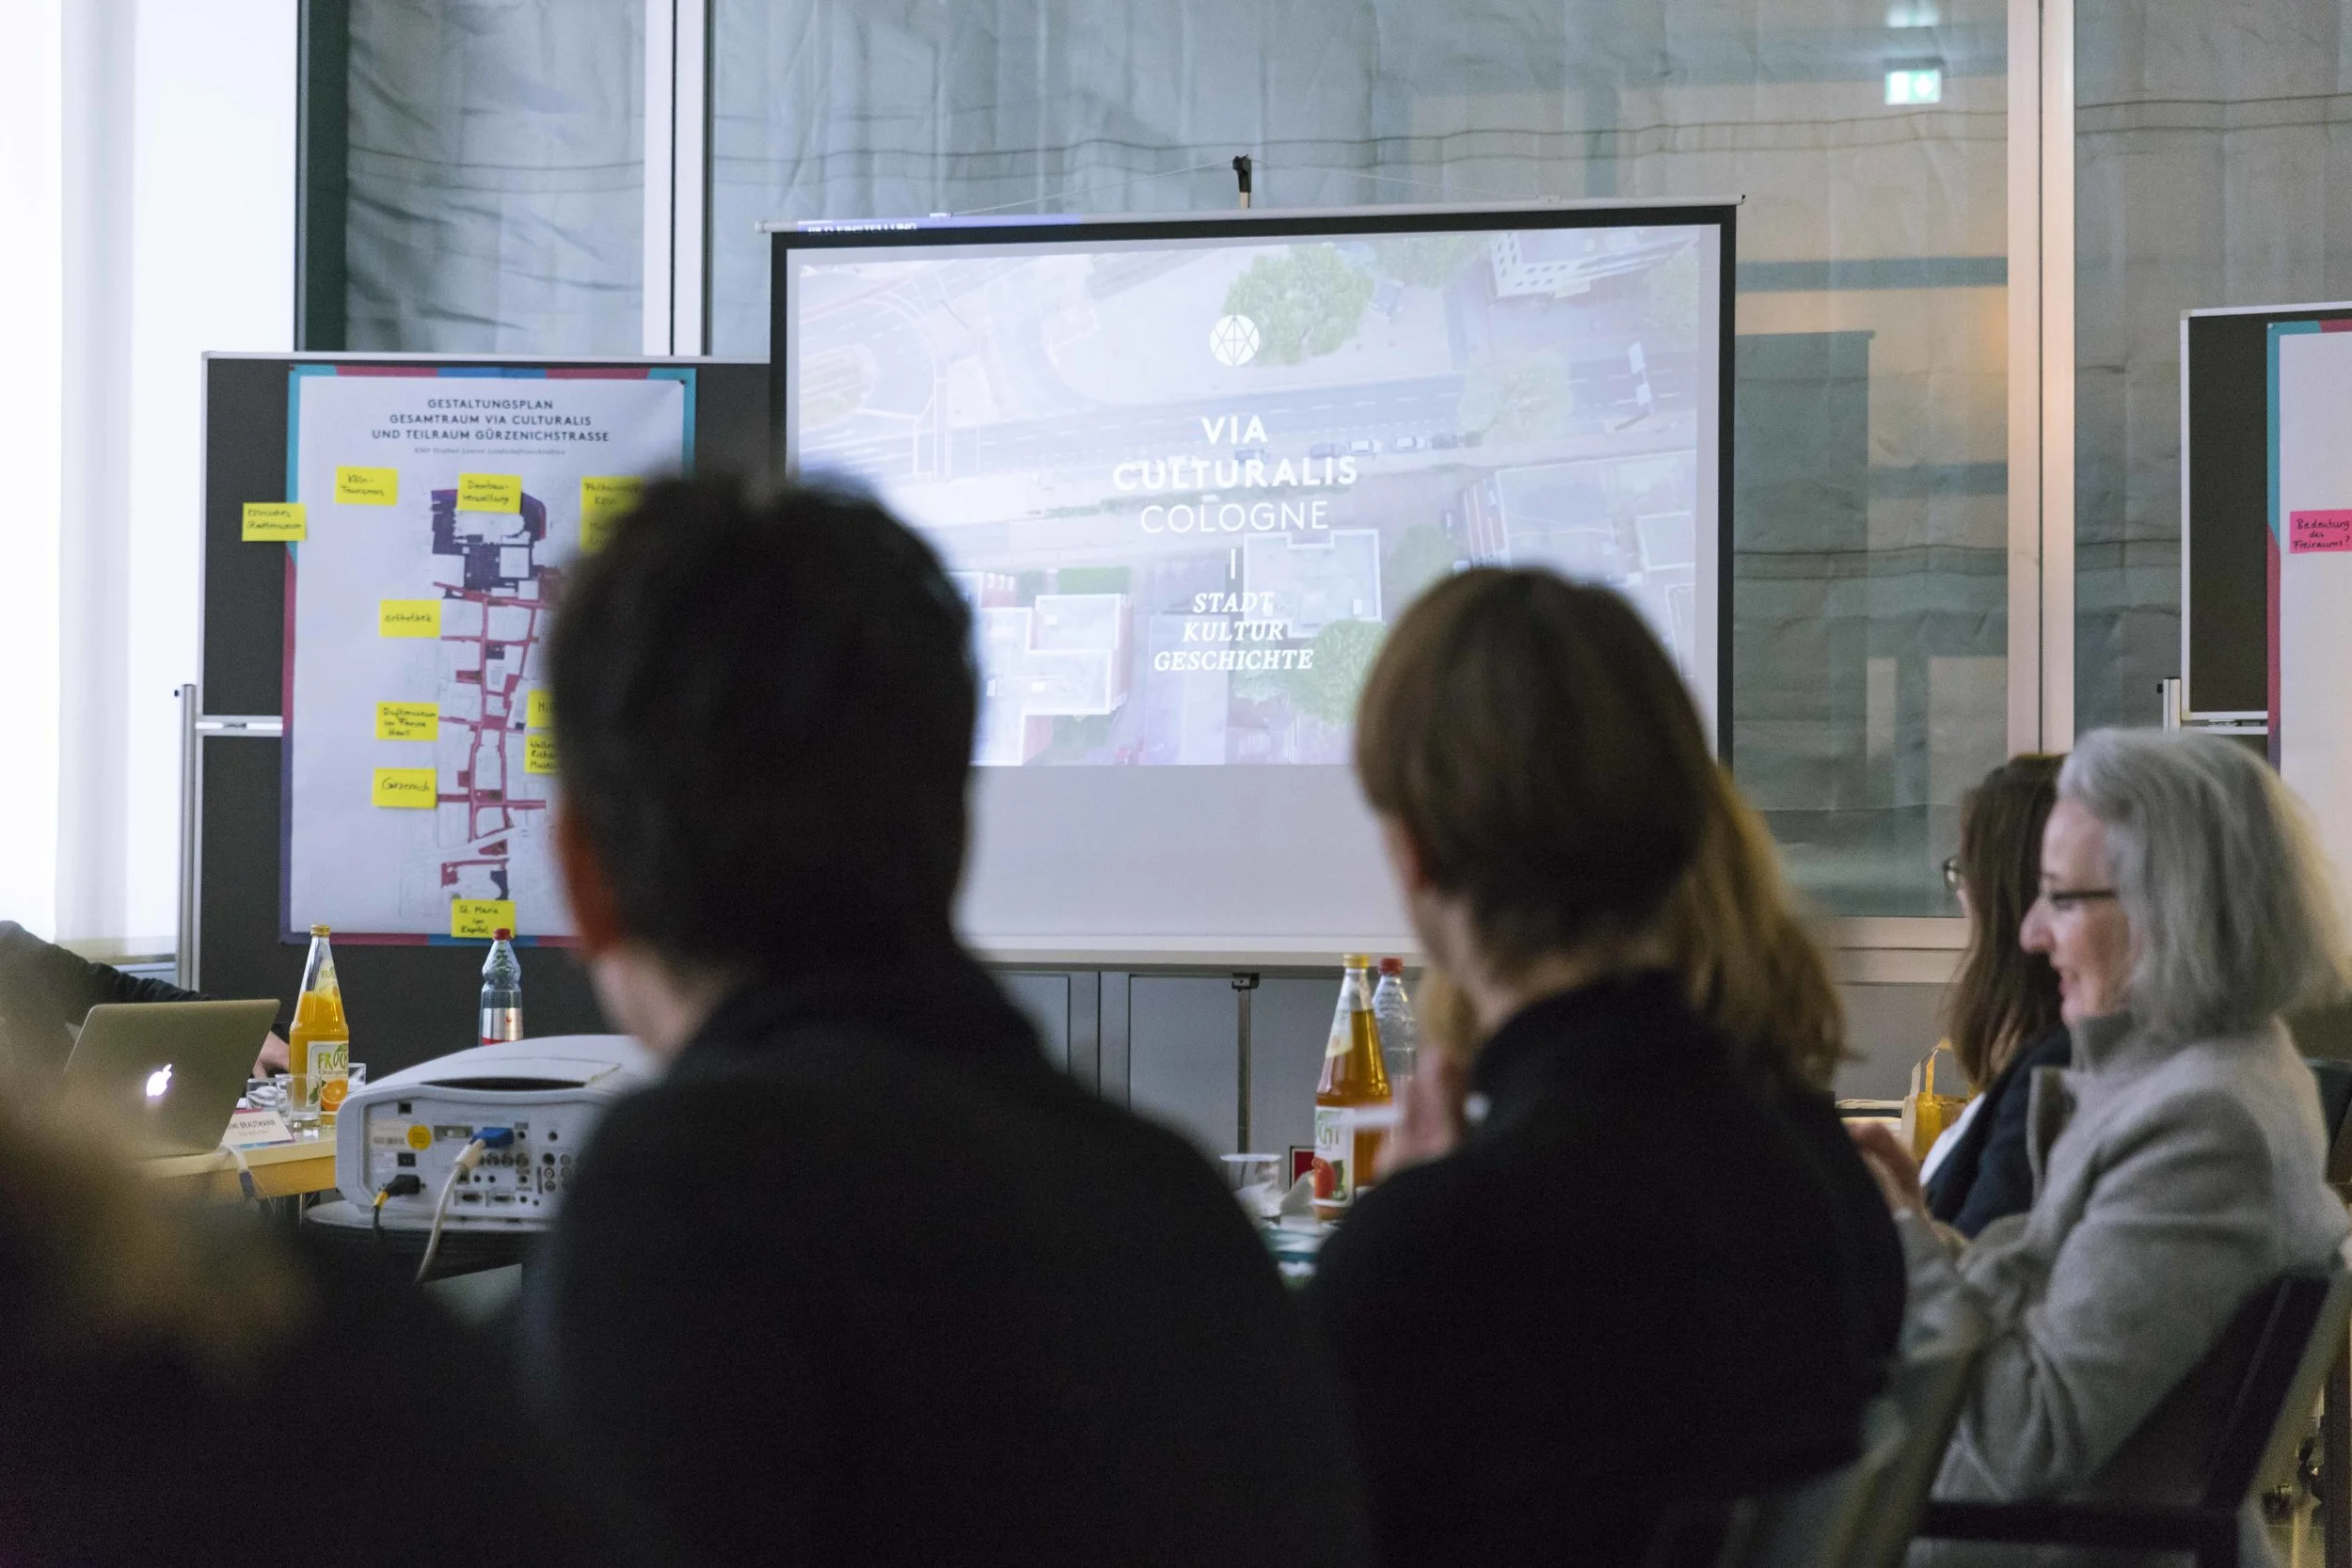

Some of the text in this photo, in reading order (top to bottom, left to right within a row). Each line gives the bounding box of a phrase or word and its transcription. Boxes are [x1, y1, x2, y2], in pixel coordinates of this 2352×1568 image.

[427, 399, 553, 410] GESTALTUNGSPLAN
[389, 414, 592, 426] GESAMTRAUM VIA CULTURALIS
[1200, 415, 1268, 445] VIA
[372, 429, 610, 442] UND TEILRAUM GÜRZENICHSTRASSE
[1113, 455, 1358, 491] CULTURALIS
[1140, 500, 1329, 534] COLOGNE
[2296, 518, 2350, 531] Bedeutung
[1193, 592, 1276, 613] STADT
[1182, 621, 1286, 642] KULTUR
[1153, 649, 1314, 672] GESCHICHTE
